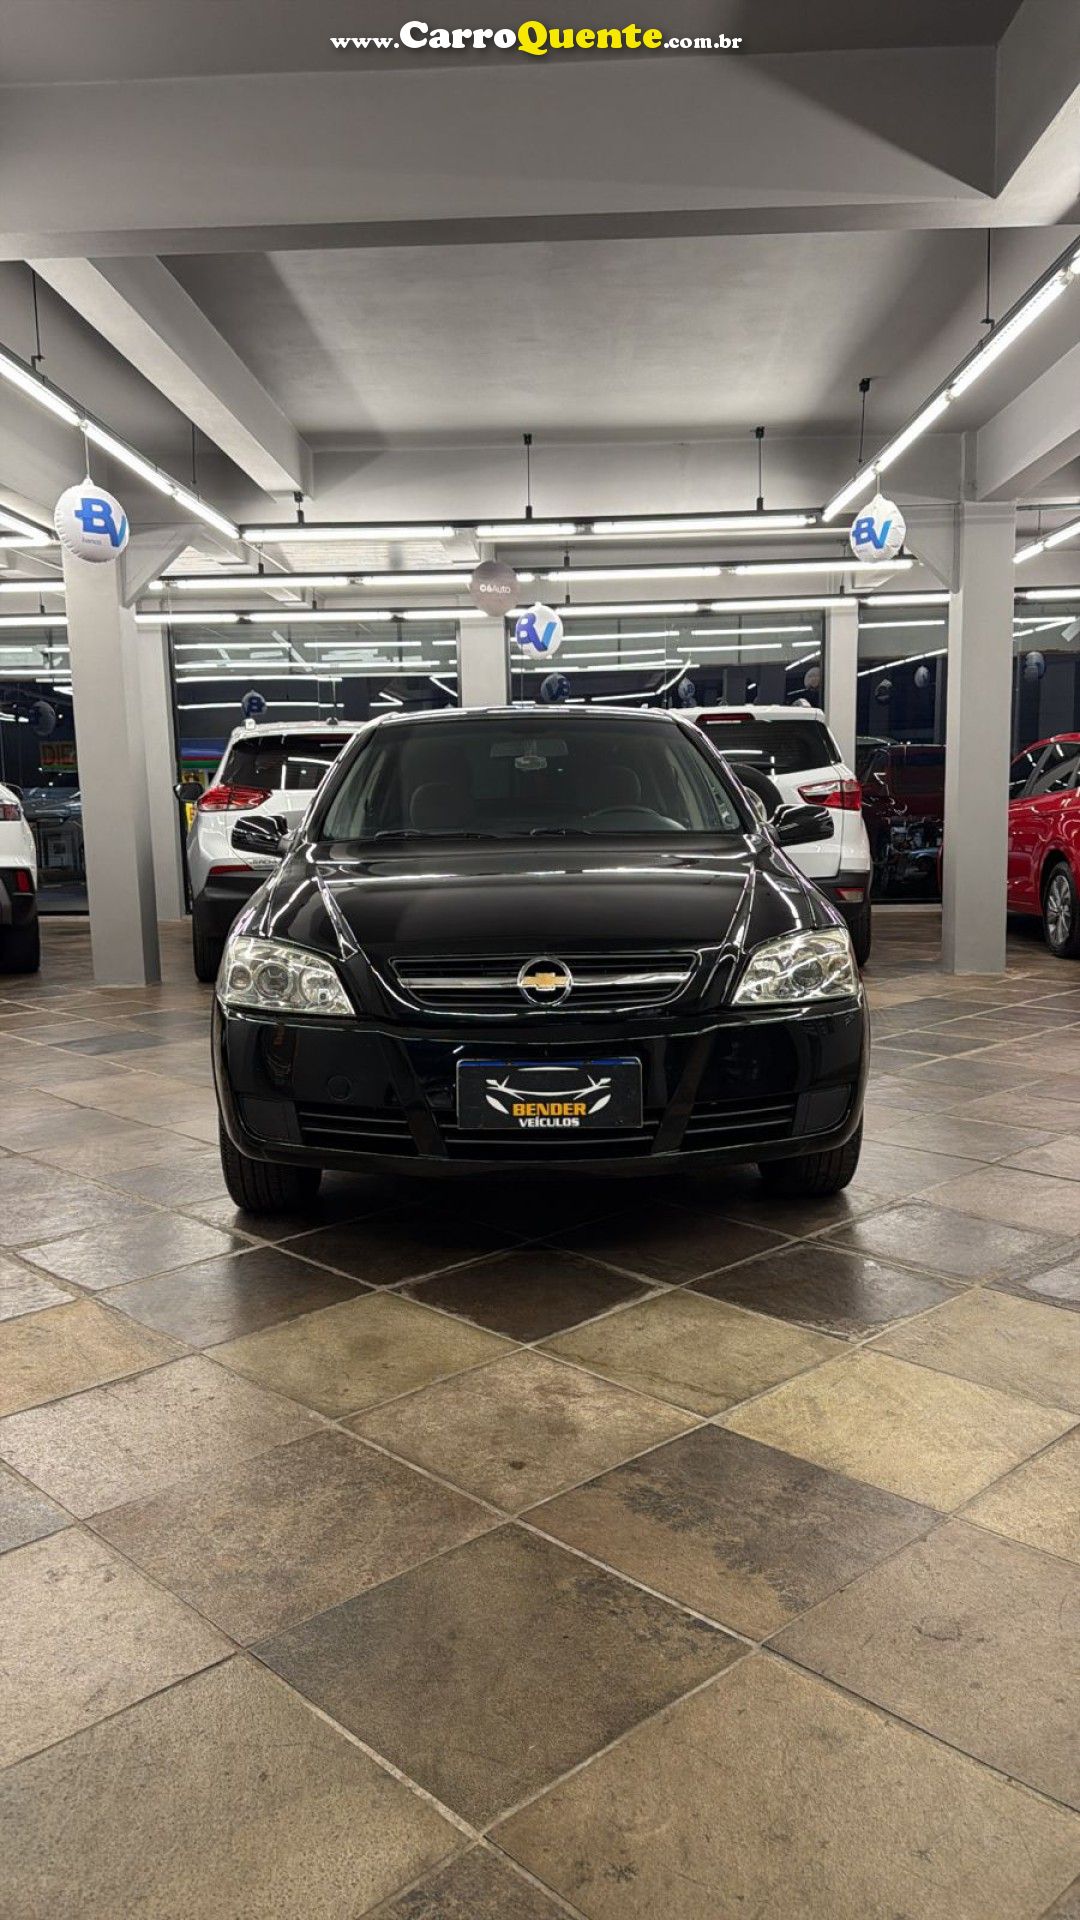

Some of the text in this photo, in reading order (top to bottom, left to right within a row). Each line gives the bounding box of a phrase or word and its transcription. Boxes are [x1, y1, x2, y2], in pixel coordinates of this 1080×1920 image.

[74, 497, 127, 547] BV
[852, 516, 893, 549] BV
[512, 1103, 587, 1117] BENDER
[518, 1116, 581, 1128] VEÍCULOS
